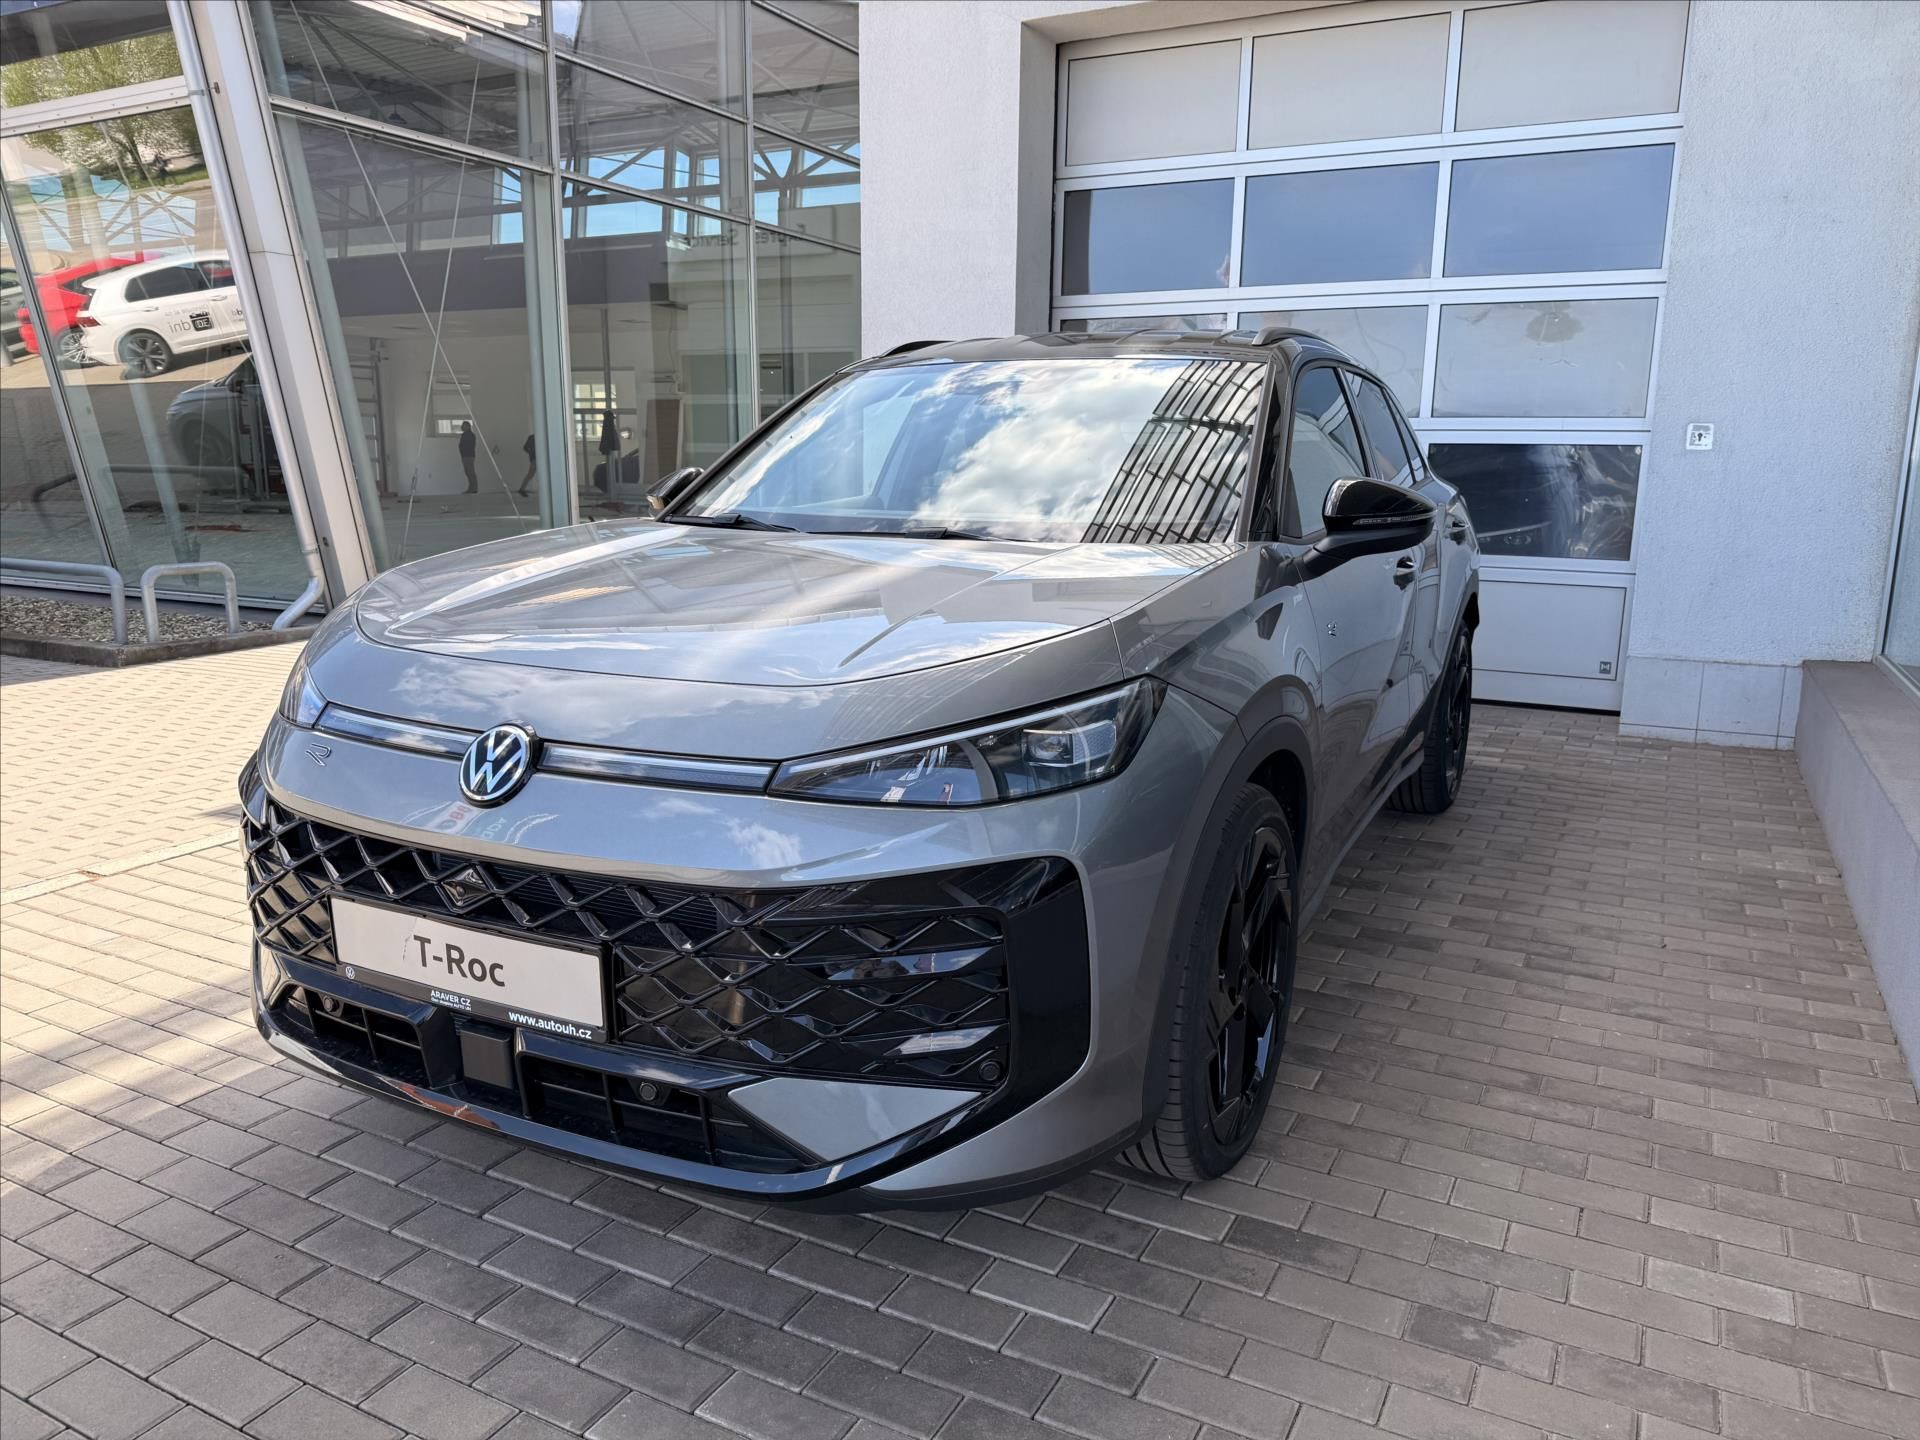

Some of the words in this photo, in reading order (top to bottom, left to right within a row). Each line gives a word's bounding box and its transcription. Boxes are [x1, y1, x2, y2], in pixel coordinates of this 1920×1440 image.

[413, 934, 506, 987] T-Roc
[431, 990, 460, 1004] ARAVER
[461, 997, 471, 1007] CZ
[508, 1011, 592, 1040] www.autouh.cz
